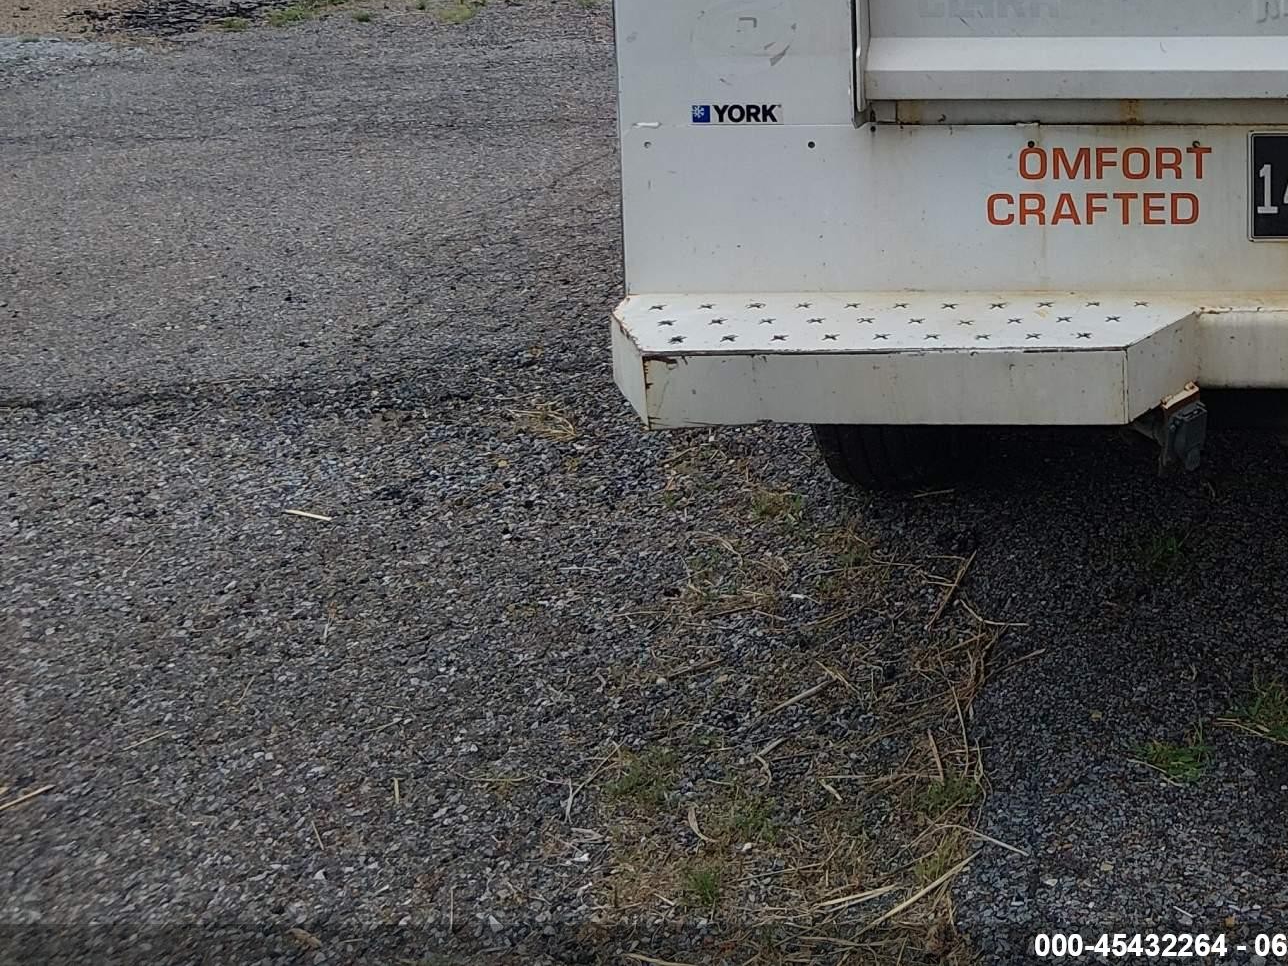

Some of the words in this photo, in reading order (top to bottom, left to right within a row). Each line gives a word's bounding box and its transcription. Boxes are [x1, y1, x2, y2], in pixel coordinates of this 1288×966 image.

[712, 104, 779, 123] YORK
[1018, 147, 1213, 180] OMFORT
[986, 192, 1200, 226] CRAFTED
